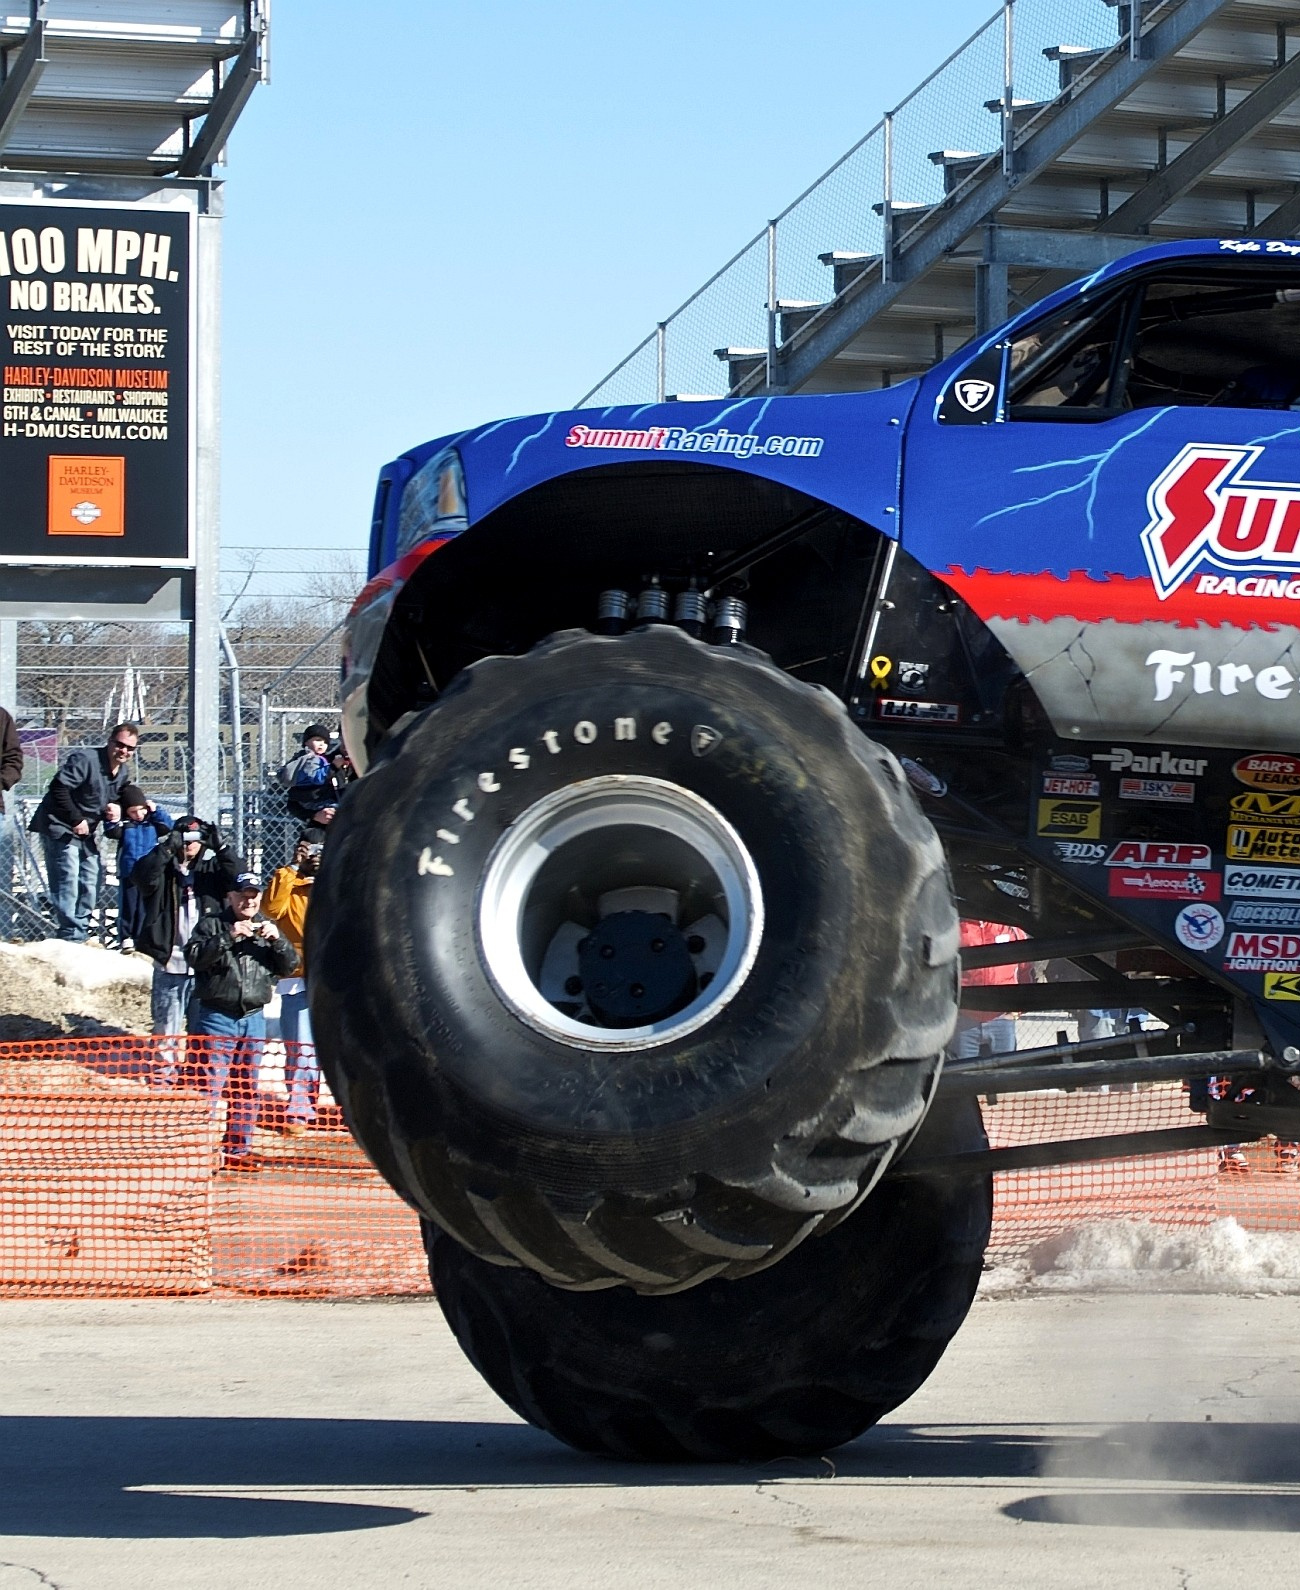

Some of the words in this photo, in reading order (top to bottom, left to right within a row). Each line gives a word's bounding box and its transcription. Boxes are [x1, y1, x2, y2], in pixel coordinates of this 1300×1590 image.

[77, 228, 179, 282] MPH.
[1219, 240, 1260, 253] Kyle
[10, 280, 47, 311] NO
[53, 281, 161, 315] BRAKES.
[7, 325, 47, 339] VISIT
[50, 326, 101, 341] TODAY
[104, 328, 134, 342] FOR
[137, 328, 168, 343] THE
[13, 341, 53, 355] REST
[56, 342, 78, 356] OF
[80, 343, 111, 357] THE
[113, 344, 165, 358] STORY.
[4, 366, 113, 387] HARLEY-DAVIDSON
[115, 369, 168, 389] MUSEUM
[3, 388, 45, 403] EXHIBITS
[52, 389, 115, 405] RESTAURANTS
[122, 391, 168, 406] SHOPPING
[3, 405, 29, 421] 6TH
[30, 406, 43, 421] &
[43, 406, 84, 422] CANAL
[97, 408, 168, 424] MILWAUKEE
[3, 423, 168, 440] H-DMUSEUM.COM
[565, 425, 824, 458] SummitRacing.com
[64, 465, 110, 476] HARLEY-
[59, 477, 114, 486] DAVIDSON
[1096, 748, 1208, 776] Parker
[1247, 758, 1295, 773] BAR'S
[1044, 778, 1093, 794] JET-HOT
[1141, 781, 1175, 792] ISKY
[417, 717, 673, 876] Firestone
[1050, 811, 1089, 825] ESAB
[1060, 842, 1108, 858] BDS
[1109, 843, 1208, 865] ARP
[1230, 958, 1299, 973] IGNITION
